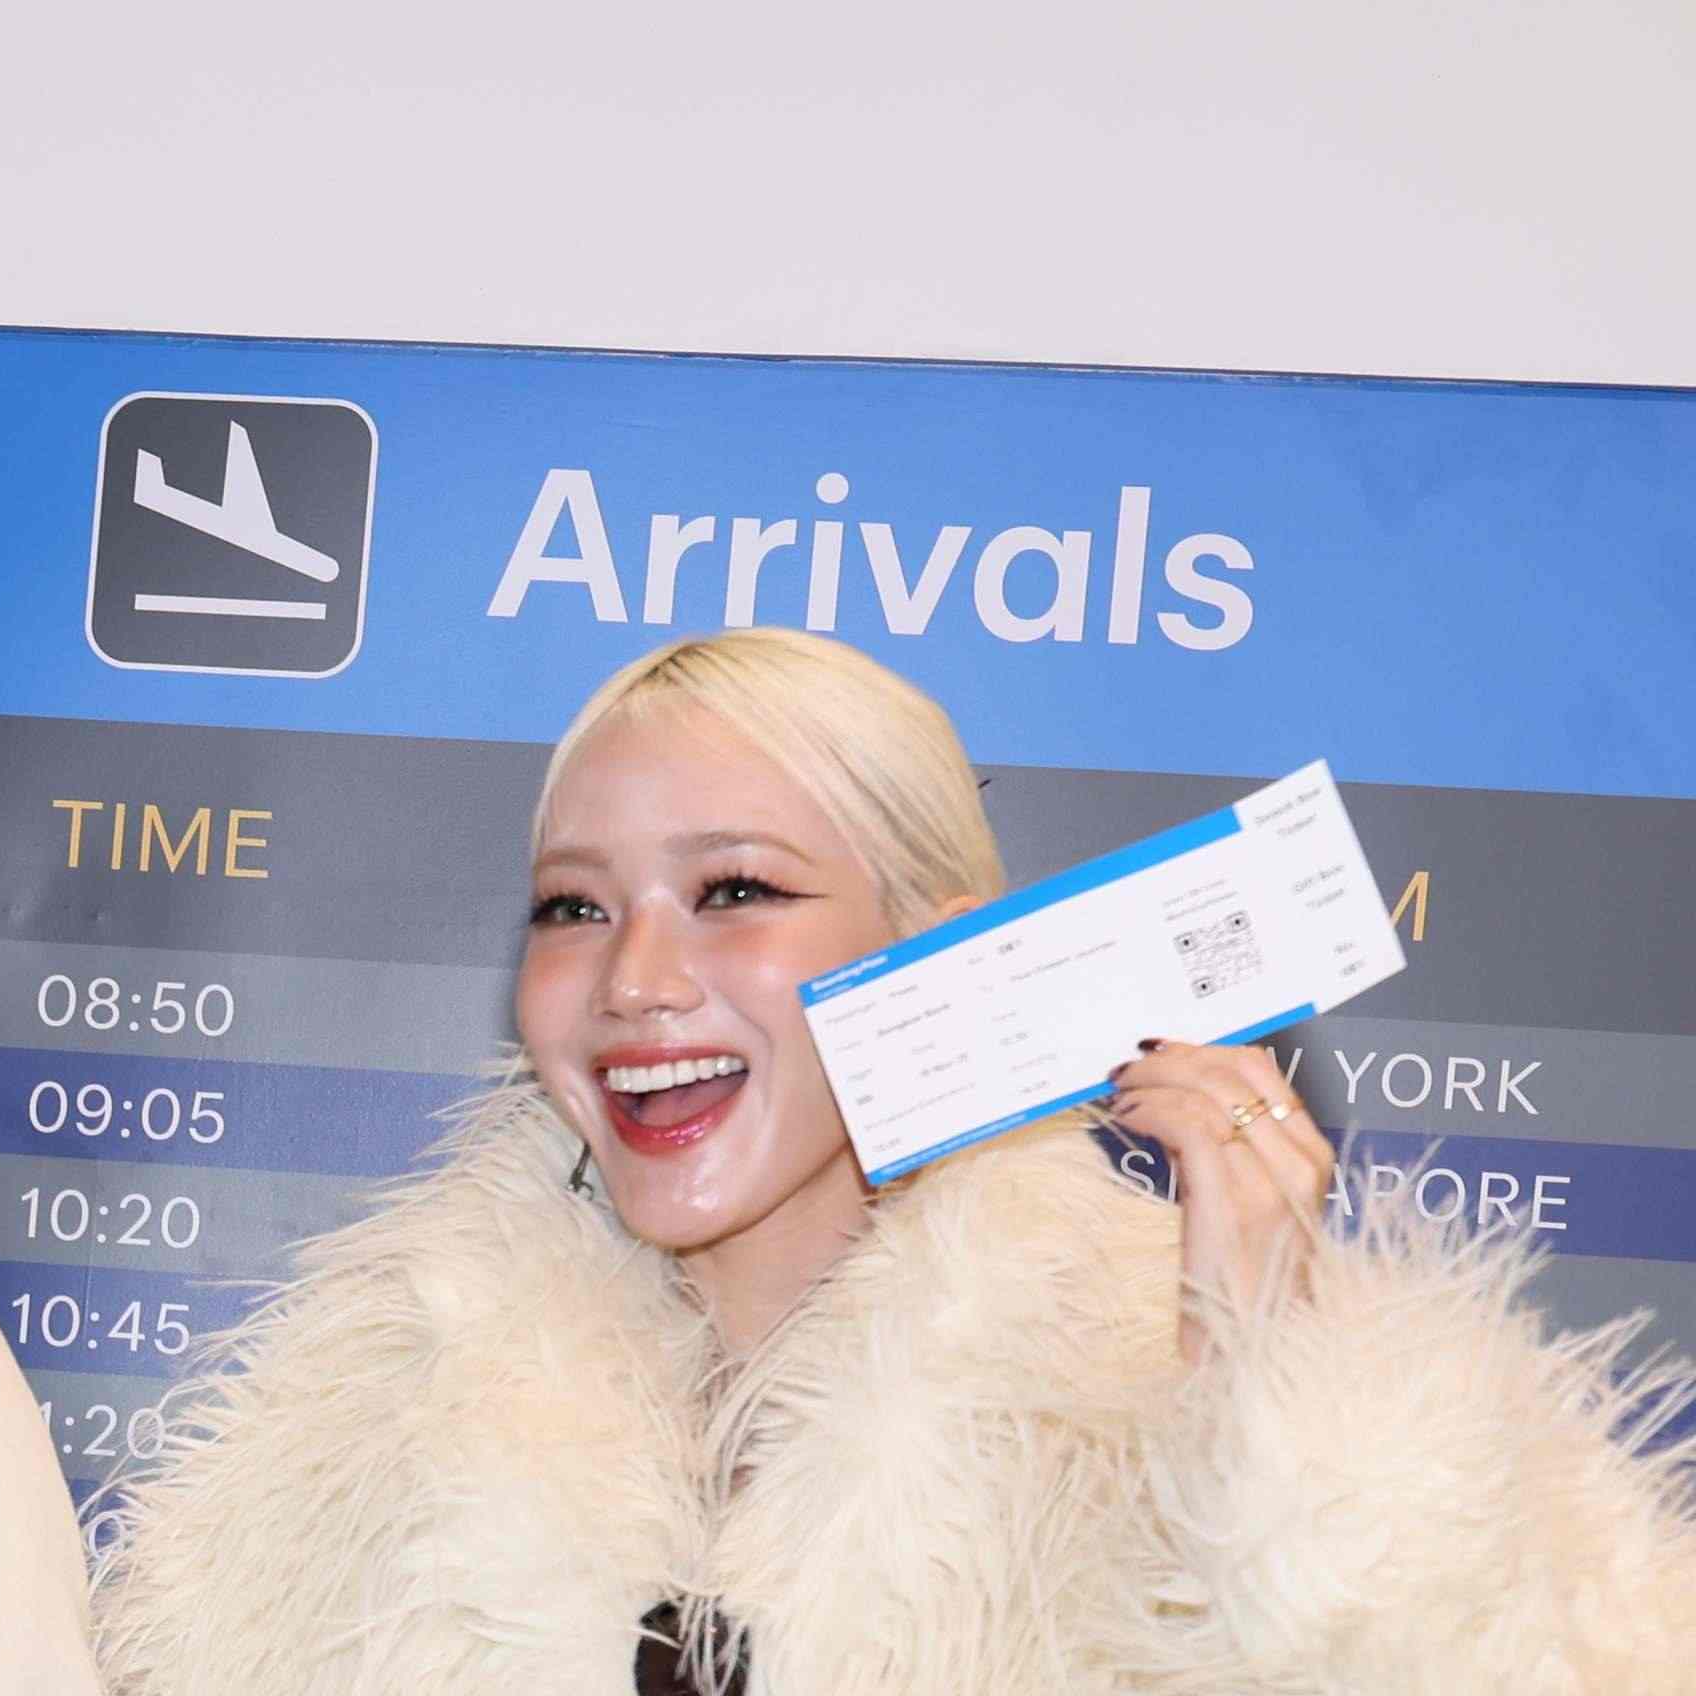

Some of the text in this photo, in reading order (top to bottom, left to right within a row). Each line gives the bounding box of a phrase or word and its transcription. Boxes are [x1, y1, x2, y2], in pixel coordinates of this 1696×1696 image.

[487, 468, 1253, 650] Arrivals
[52, 799, 273, 878] TIME
[37, 974, 235, 1037] 08:50
[28, 1080, 226, 1144] 09:05
[1334, 1050, 1543, 1116] YORK
[20, 1187, 201, 1249] 10:20
[10, 1293, 191, 1356] 10:45
